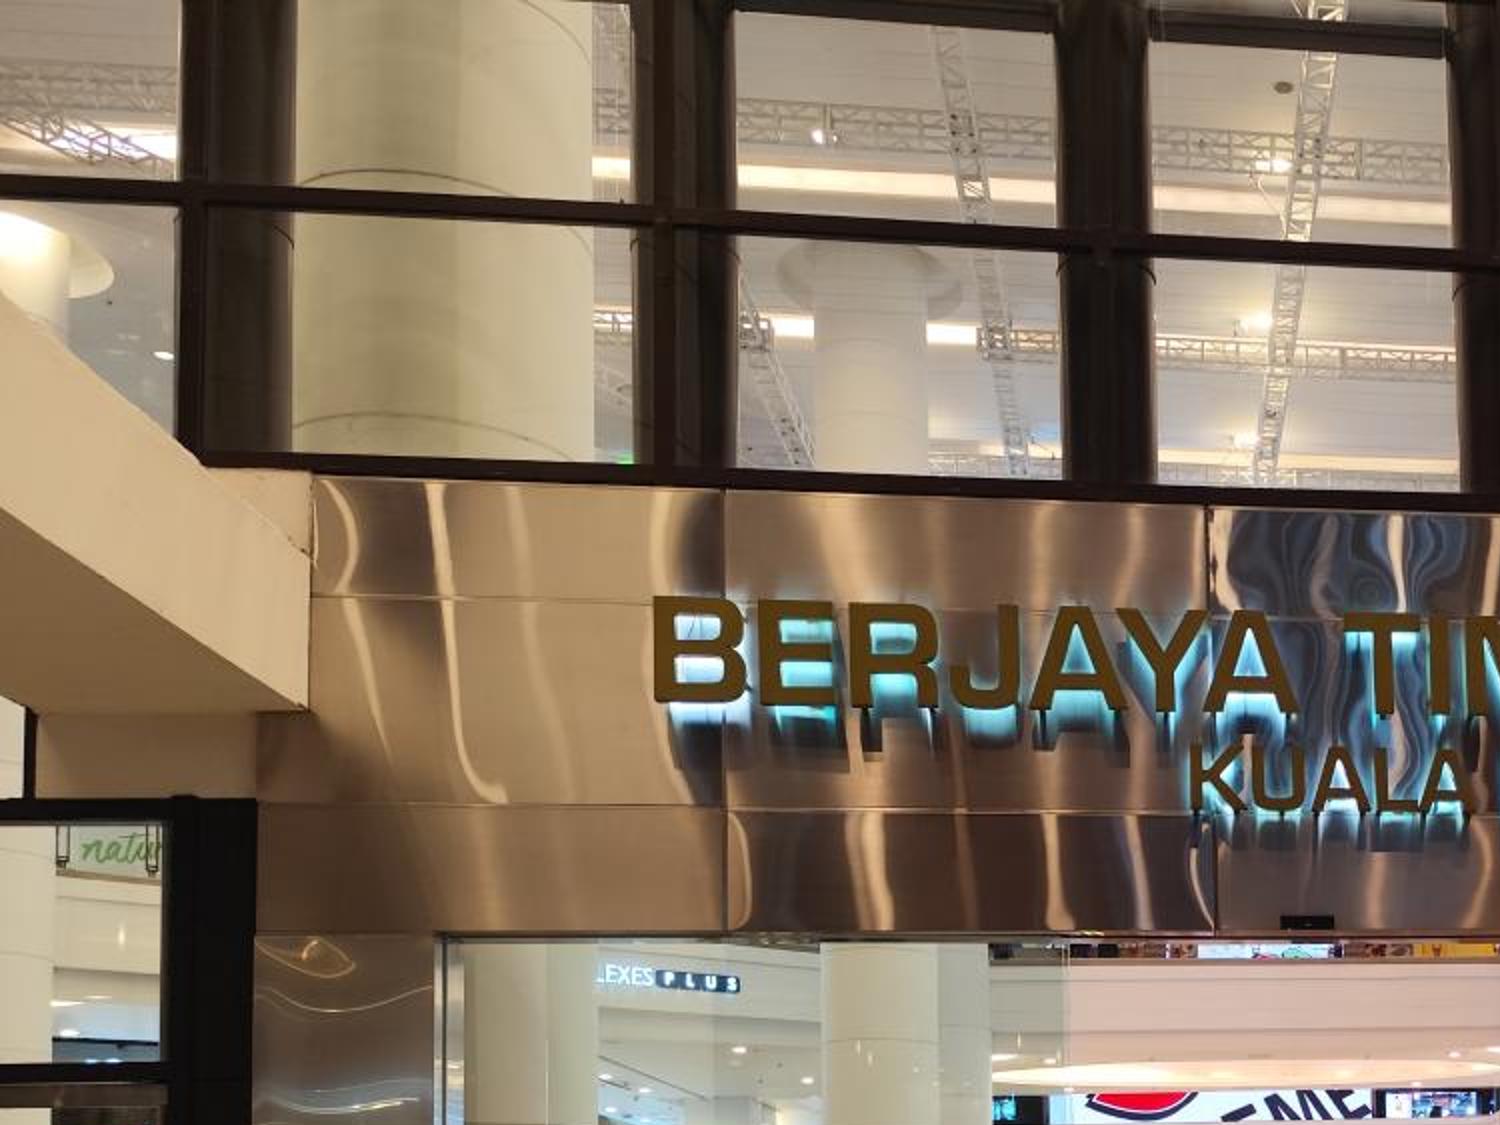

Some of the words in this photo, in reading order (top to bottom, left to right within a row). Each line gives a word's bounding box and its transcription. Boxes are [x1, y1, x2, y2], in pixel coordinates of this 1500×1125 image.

[653, 595, 1298, 716] BERJAYA
[1189, 744, 1478, 815] KUALA
[663, 971, 738, 991] PLUS
